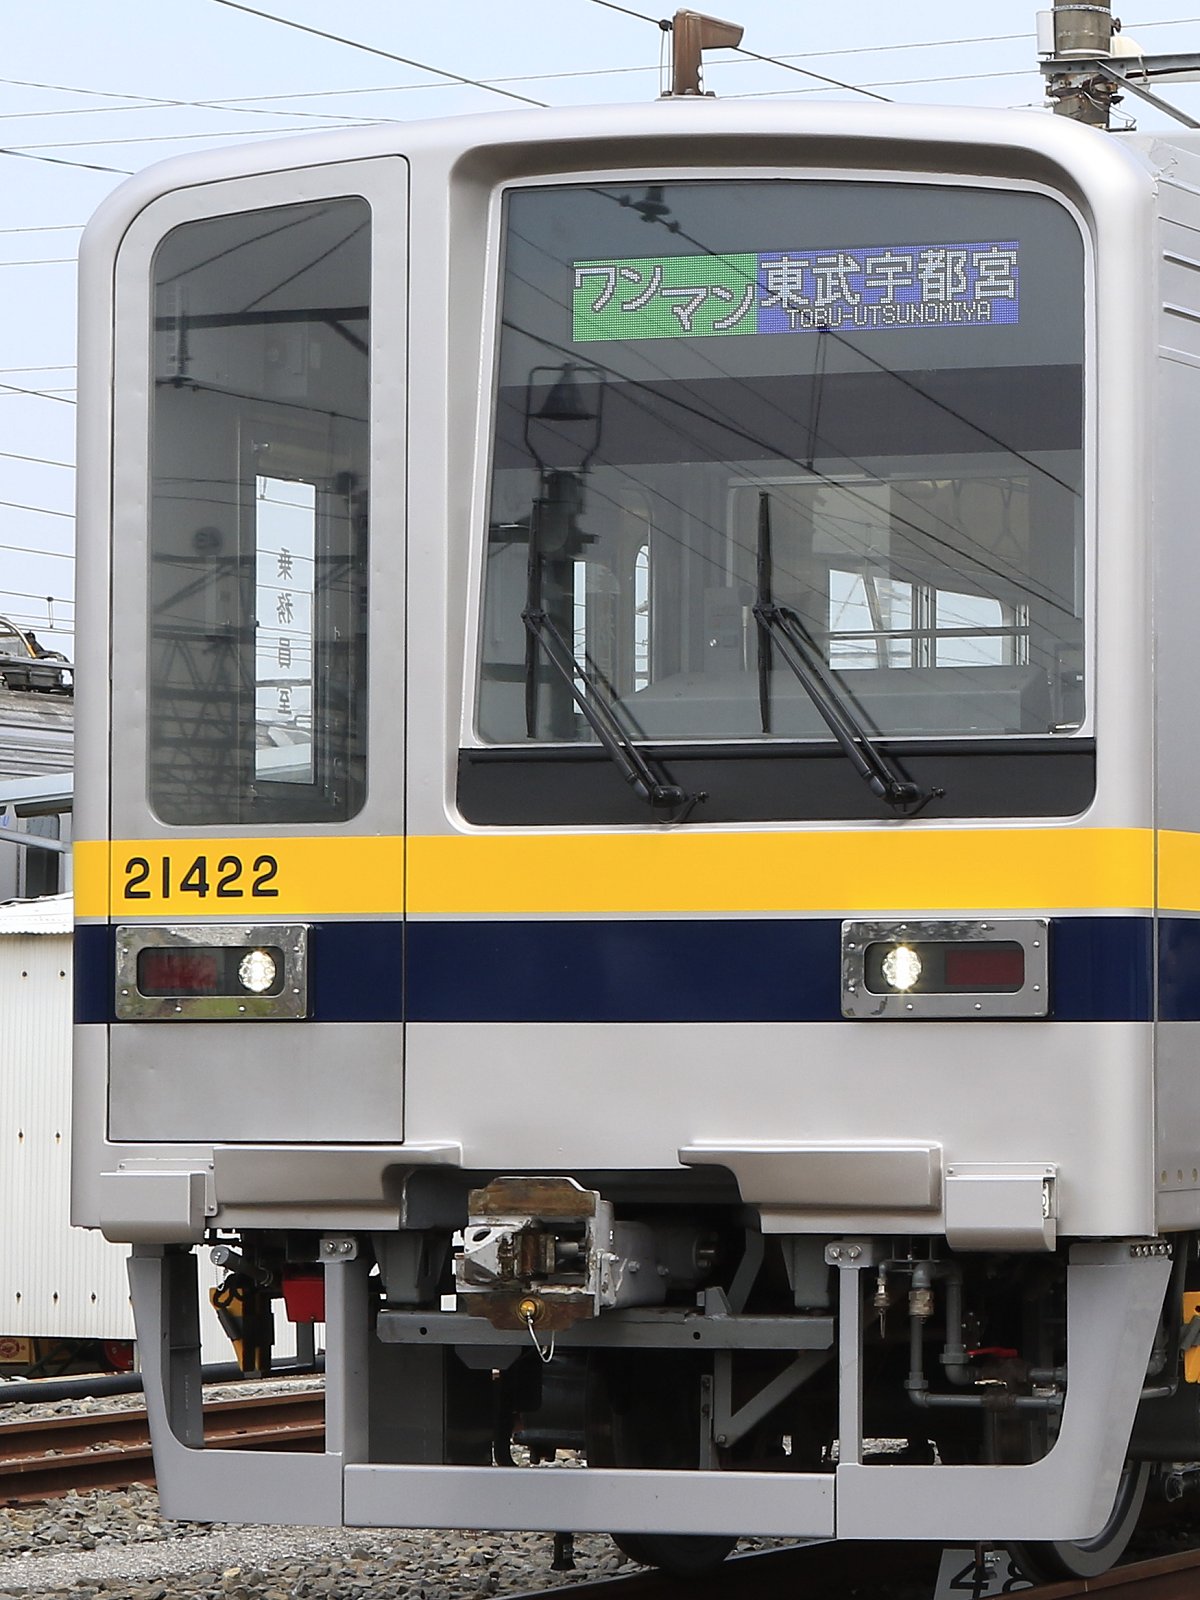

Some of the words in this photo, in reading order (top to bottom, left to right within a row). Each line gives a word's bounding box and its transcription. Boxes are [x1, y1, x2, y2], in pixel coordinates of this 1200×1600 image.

[573, 265, 754, 331] ワンマン
[760, 246, 1018, 308] 東武宇都宮
[786, 300, 992, 329] TOBU-UTSUNOMIYA
[124, 855, 279, 899] 21422
